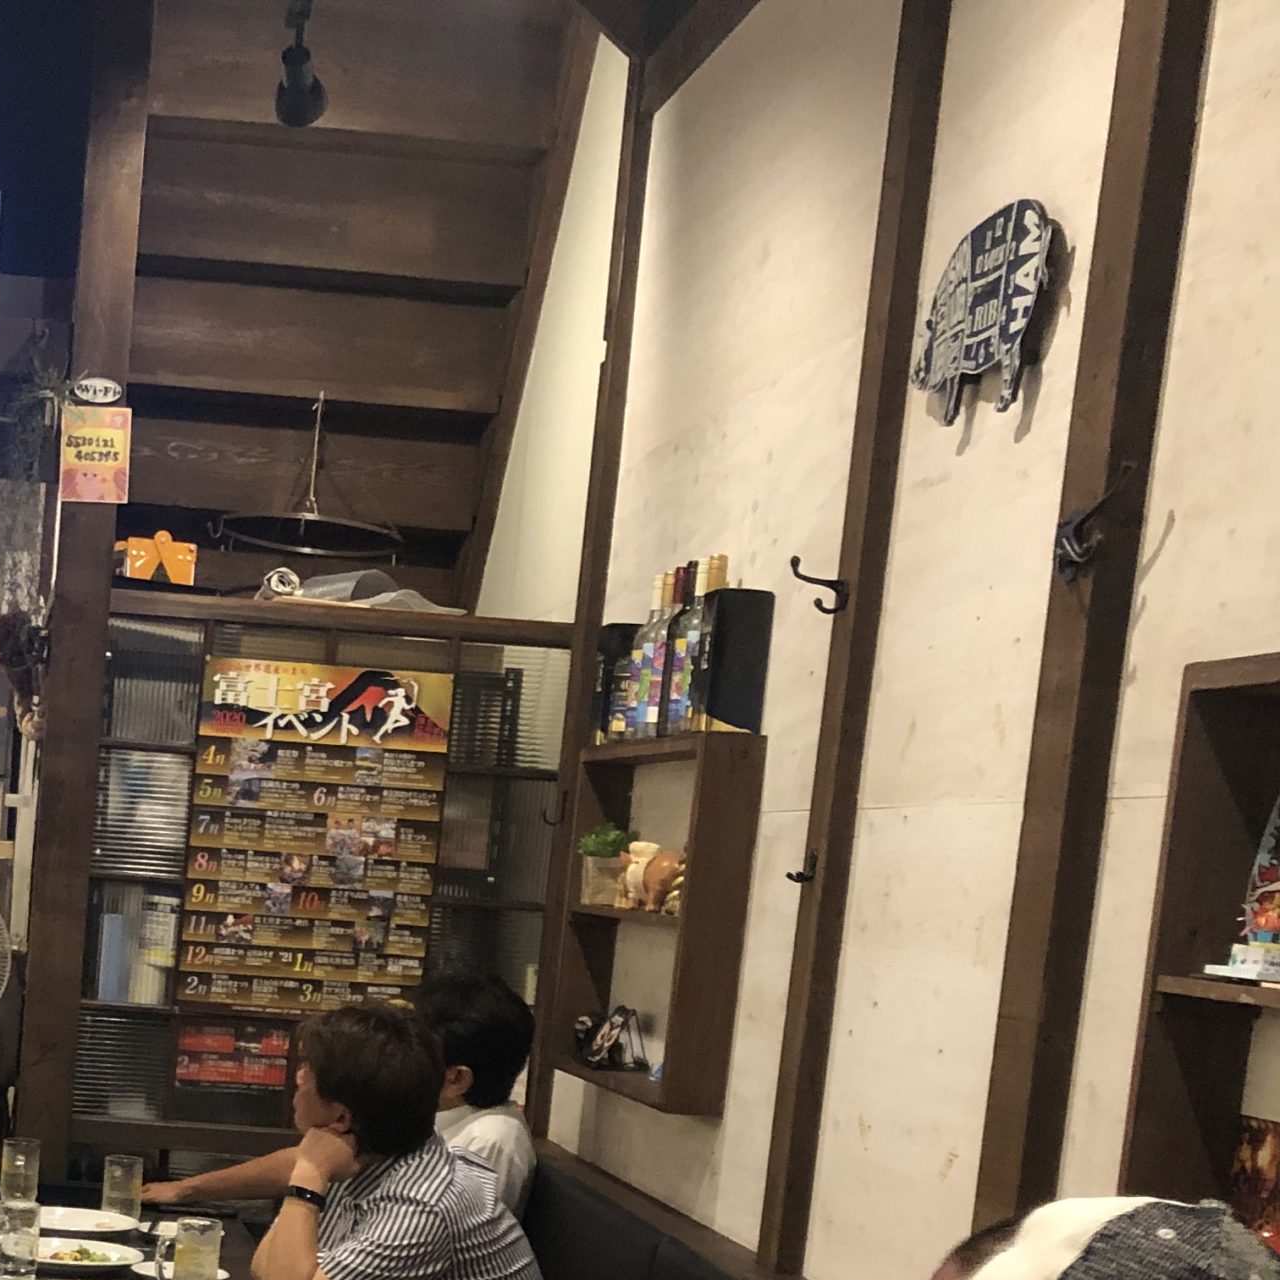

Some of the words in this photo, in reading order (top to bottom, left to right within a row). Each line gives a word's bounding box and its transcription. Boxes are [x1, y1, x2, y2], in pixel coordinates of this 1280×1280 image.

[1009, 210, 1041, 334] HAM
[79, 384, 117, 397] Wi-Fi
[213, 671, 335, 712] 富士宮
[253, 711, 359, 744] イベント
